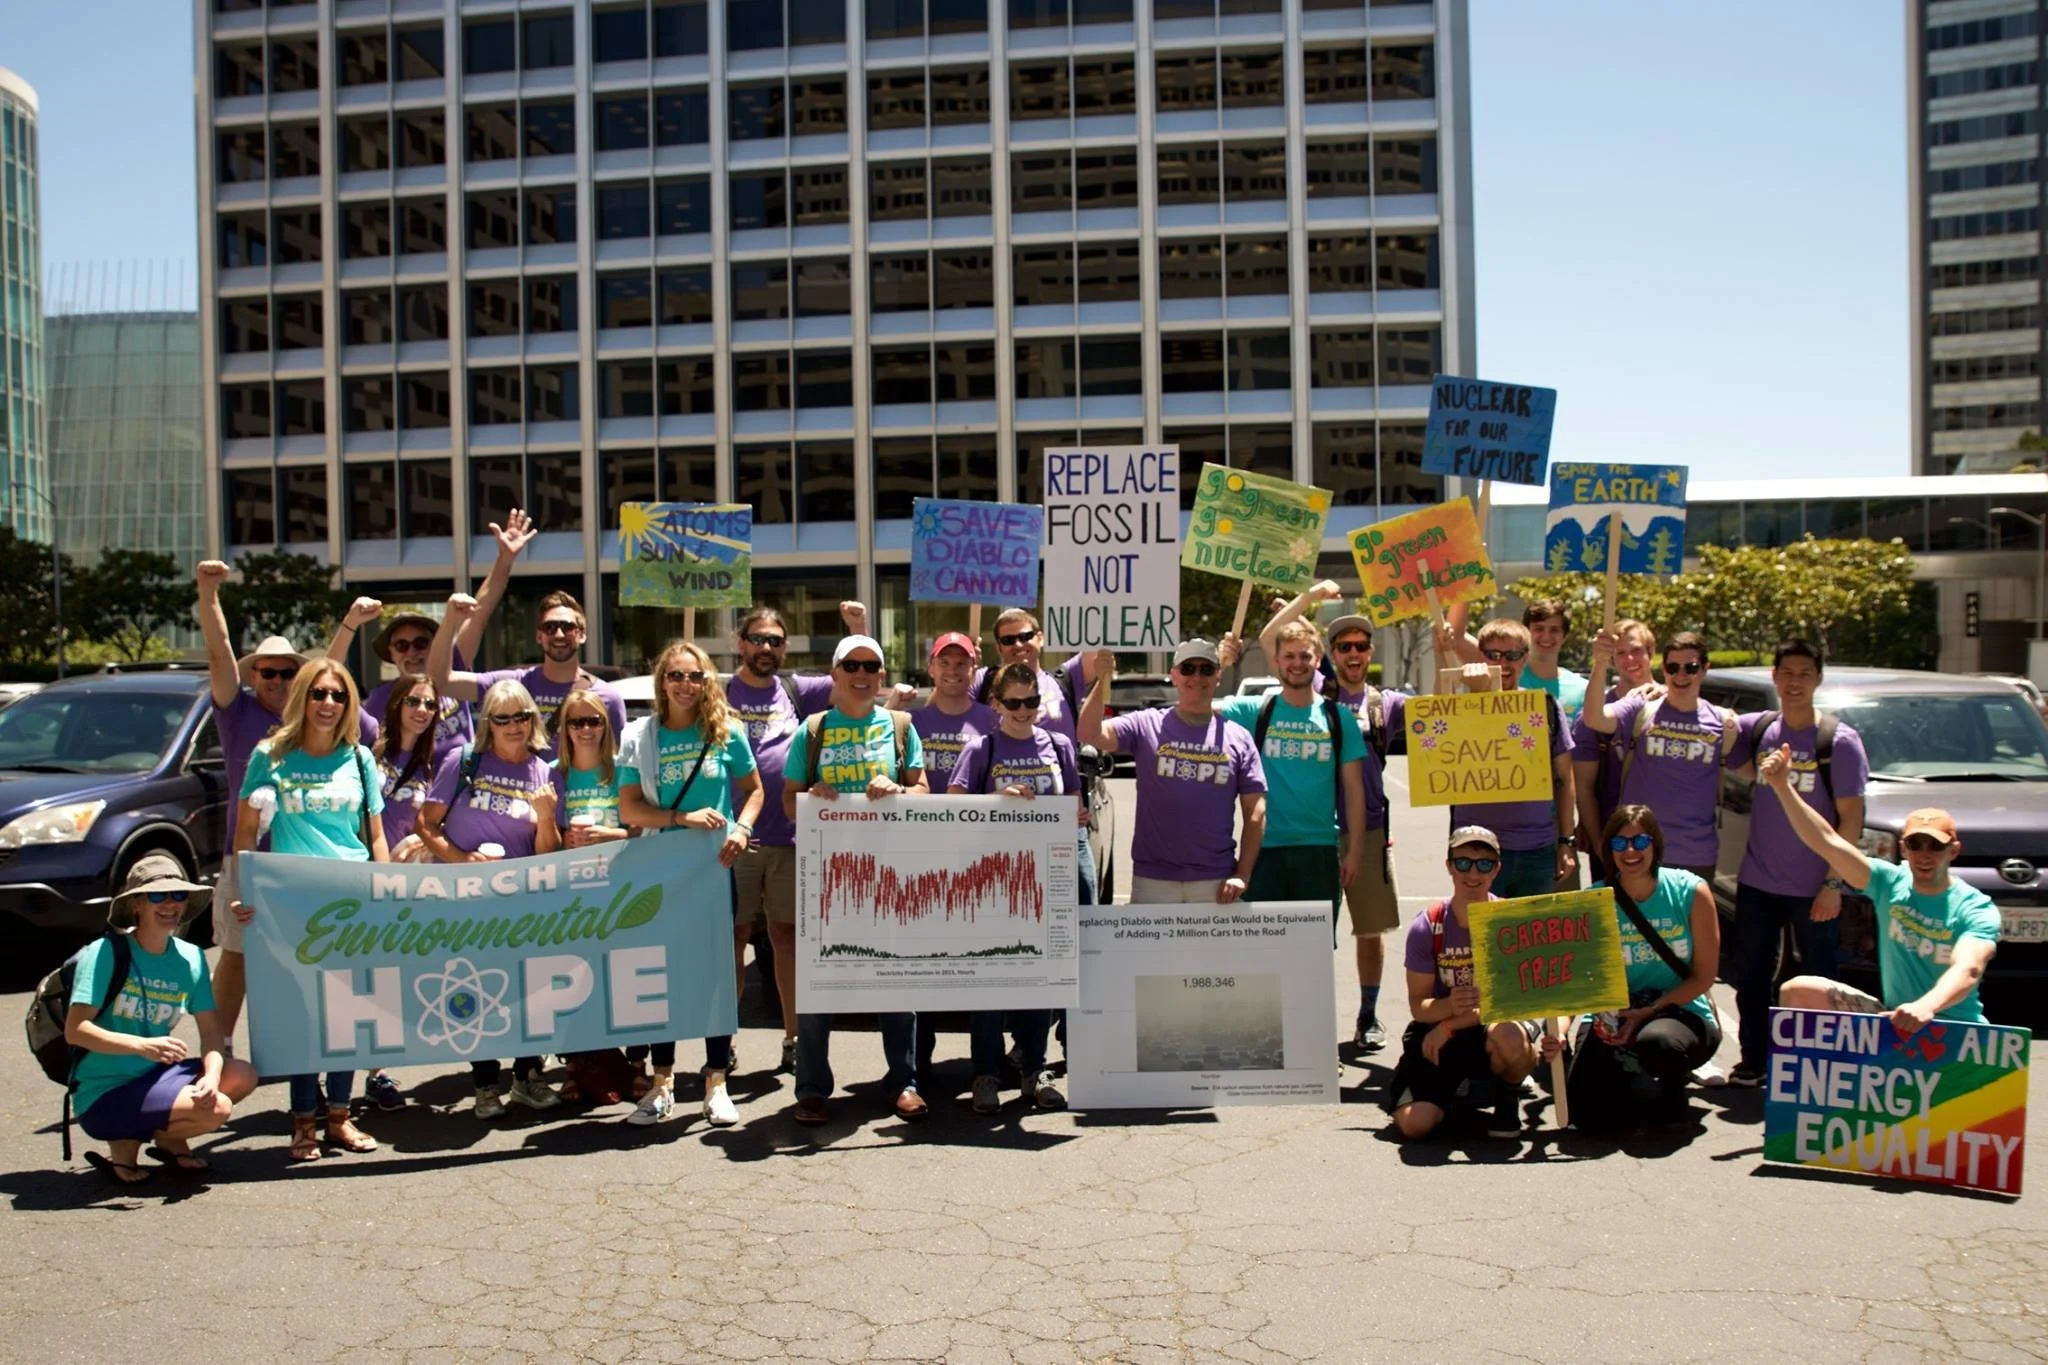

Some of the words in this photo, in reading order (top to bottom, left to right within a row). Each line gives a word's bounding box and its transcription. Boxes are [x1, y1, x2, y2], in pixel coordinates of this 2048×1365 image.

[1436, 383, 1532, 418] NUCLEAR
[1445, 419, 1470, 438] FOR
[1479, 422, 1508, 442] OUR
[1048, 453, 1175, 496] REPLACE
[1454, 446, 1539, 482] FUTURE
[1574, 478, 1658, 503] EARTH
[664, 510, 751, 537] ATOMS
[940, 506, 1028, 541] SAVE
[1048, 502, 1175, 545] FOSSIL
[1239, 488, 1320, 530] green
[640, 541, 685, 564] SUN
[926, 540, 1030, 569] DIABLO
[1194, 540, 1310, 581] nuclear
[1355, 530, 1385, 564] go
[1379, 525, 1448, 578] green
[668, 571, 733, 590] WIND
[935, 567, 1028, 595] CANYON
[1084, 555, 1139, 594] NOT
[1370, 589, 1399, 619] go
[1048, 605, 1176, 647] NUCLEAR
[535, 695, 564, 704] MARC
[1415, 697, 1460, 718] SAVE
[1480, 693, 1535, 715] EARTH
[1440, 738, 1511, 765] SAVE
[1429, 764, 1526, 794] DIABLO
[819, 808, 878, 822] German
[882, 811, 902, 822] vs.
[905, 808, 955, 822] French
[958, 810, 986, 823] CO2
[989, 809, 1060, 823] Emissions
[371, 862, 557, 902] MARCH
[569, 864, 609, 882] FOR
[296, 881, 632, 965] Environmental
[1079, 917, 1119, 929] eplacing
[1121, 916, 1152, 926] Diablo
[1153, 916, 1174, 925] with
[1176, 915, 1210, 925] Natural
[1212, 915, 1230, 925] Gas
[1231, 914, 1261, 924] Would
[1263, 914, 1275, 923] be
[1277, 914, 1326, 925] Equivalent
[1114, 930, 1124, 938] of
[1126, 930, 1160, 940] Adding
[1176, 929, 1209, 938] Million
[1210, 928, 1231, 937] Cars
[1233, 928, 1242, 936] to
[1244, 927, 1260, 936] the
[1262, 927, 1286, 936] Road
[1497, 912, 1590, 955] CARBON
[1517, 953, 1575, 992] FREE
[1771, 1010, 1880, 1055] CLEAN
[1956, 1027, 2025, 1069] AIR
[1770, 1053, 1942, 1121] ENERGY
[1795, 1111, 2022, 1190] EQUALITY
